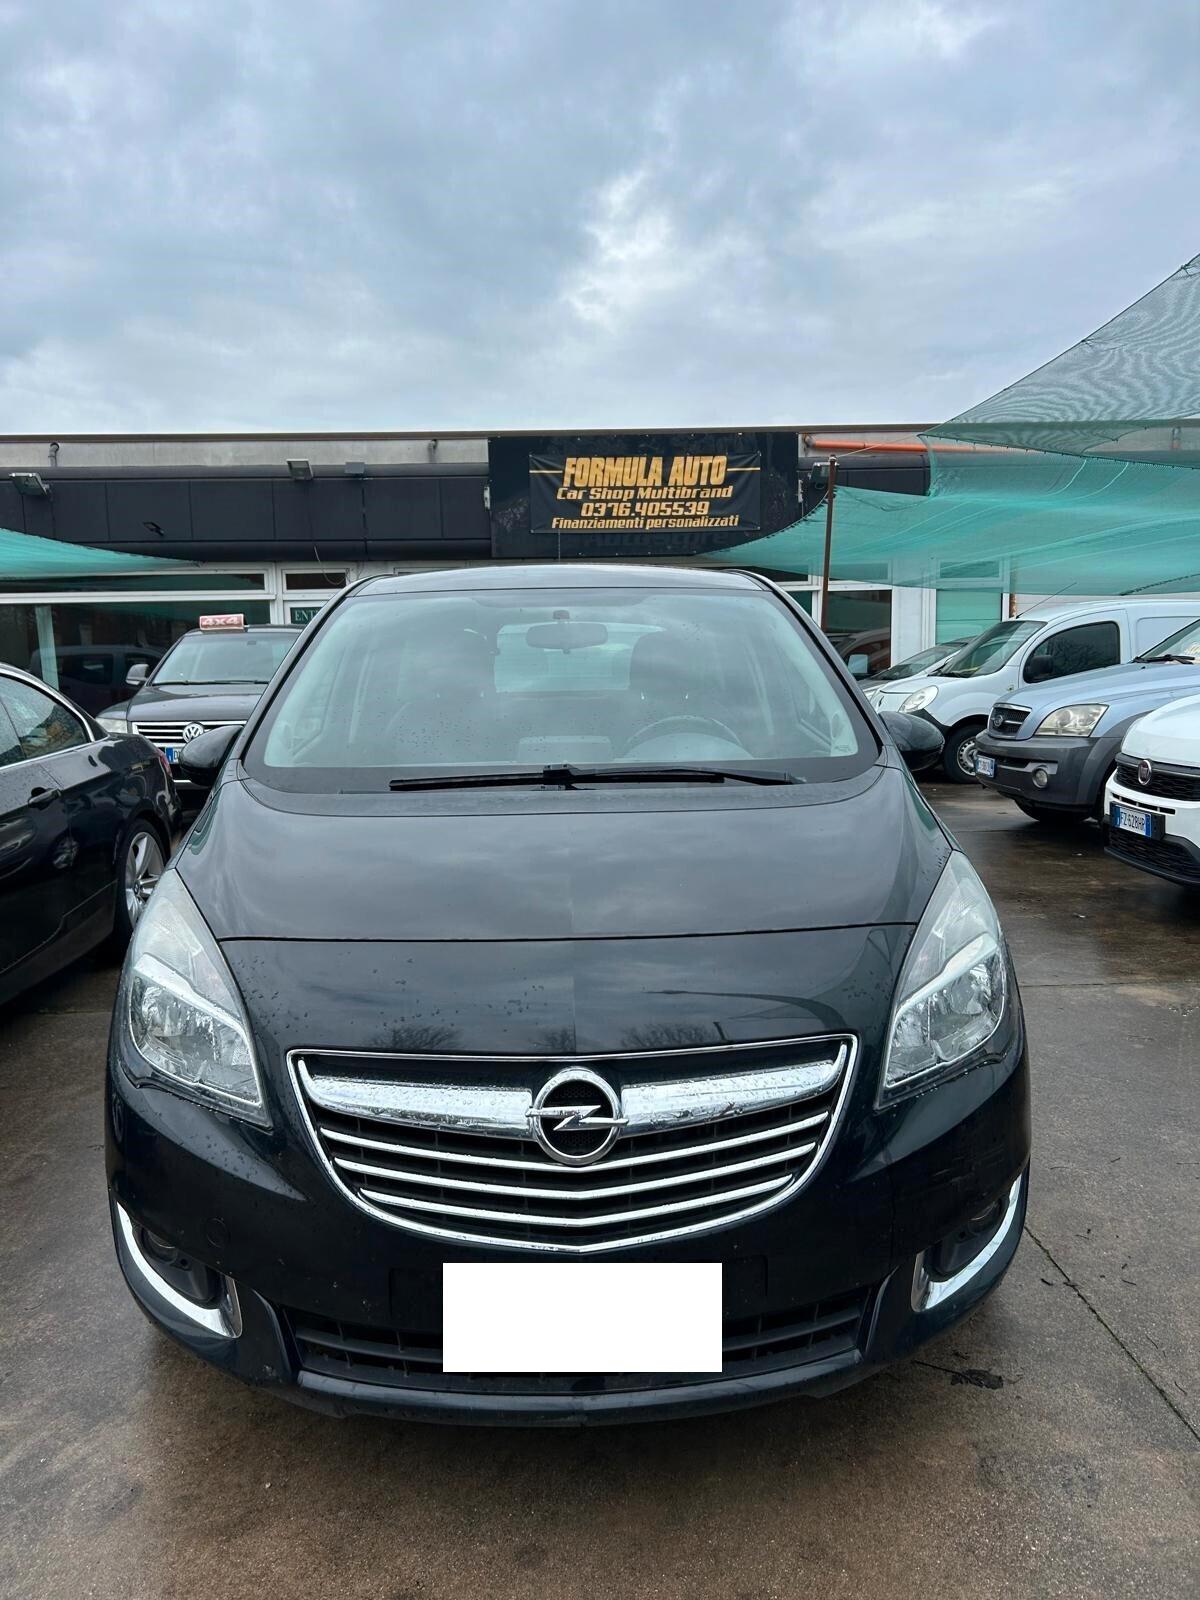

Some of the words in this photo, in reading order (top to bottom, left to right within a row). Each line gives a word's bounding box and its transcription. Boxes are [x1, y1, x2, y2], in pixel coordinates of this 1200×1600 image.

[563, 456, 663, 487] FORMULA
[668, 456, 727, 486] AUTO
[557, 488, 587, 500] Car
[589, 487, 635, 501] Shop
[637, 486, 733, 499] Multibrand
[581, 502, 710, 517] 0376.405539
[552, 517, 643, 529] Finanziamenti
[645, 515, 739, 530] personalizzati
